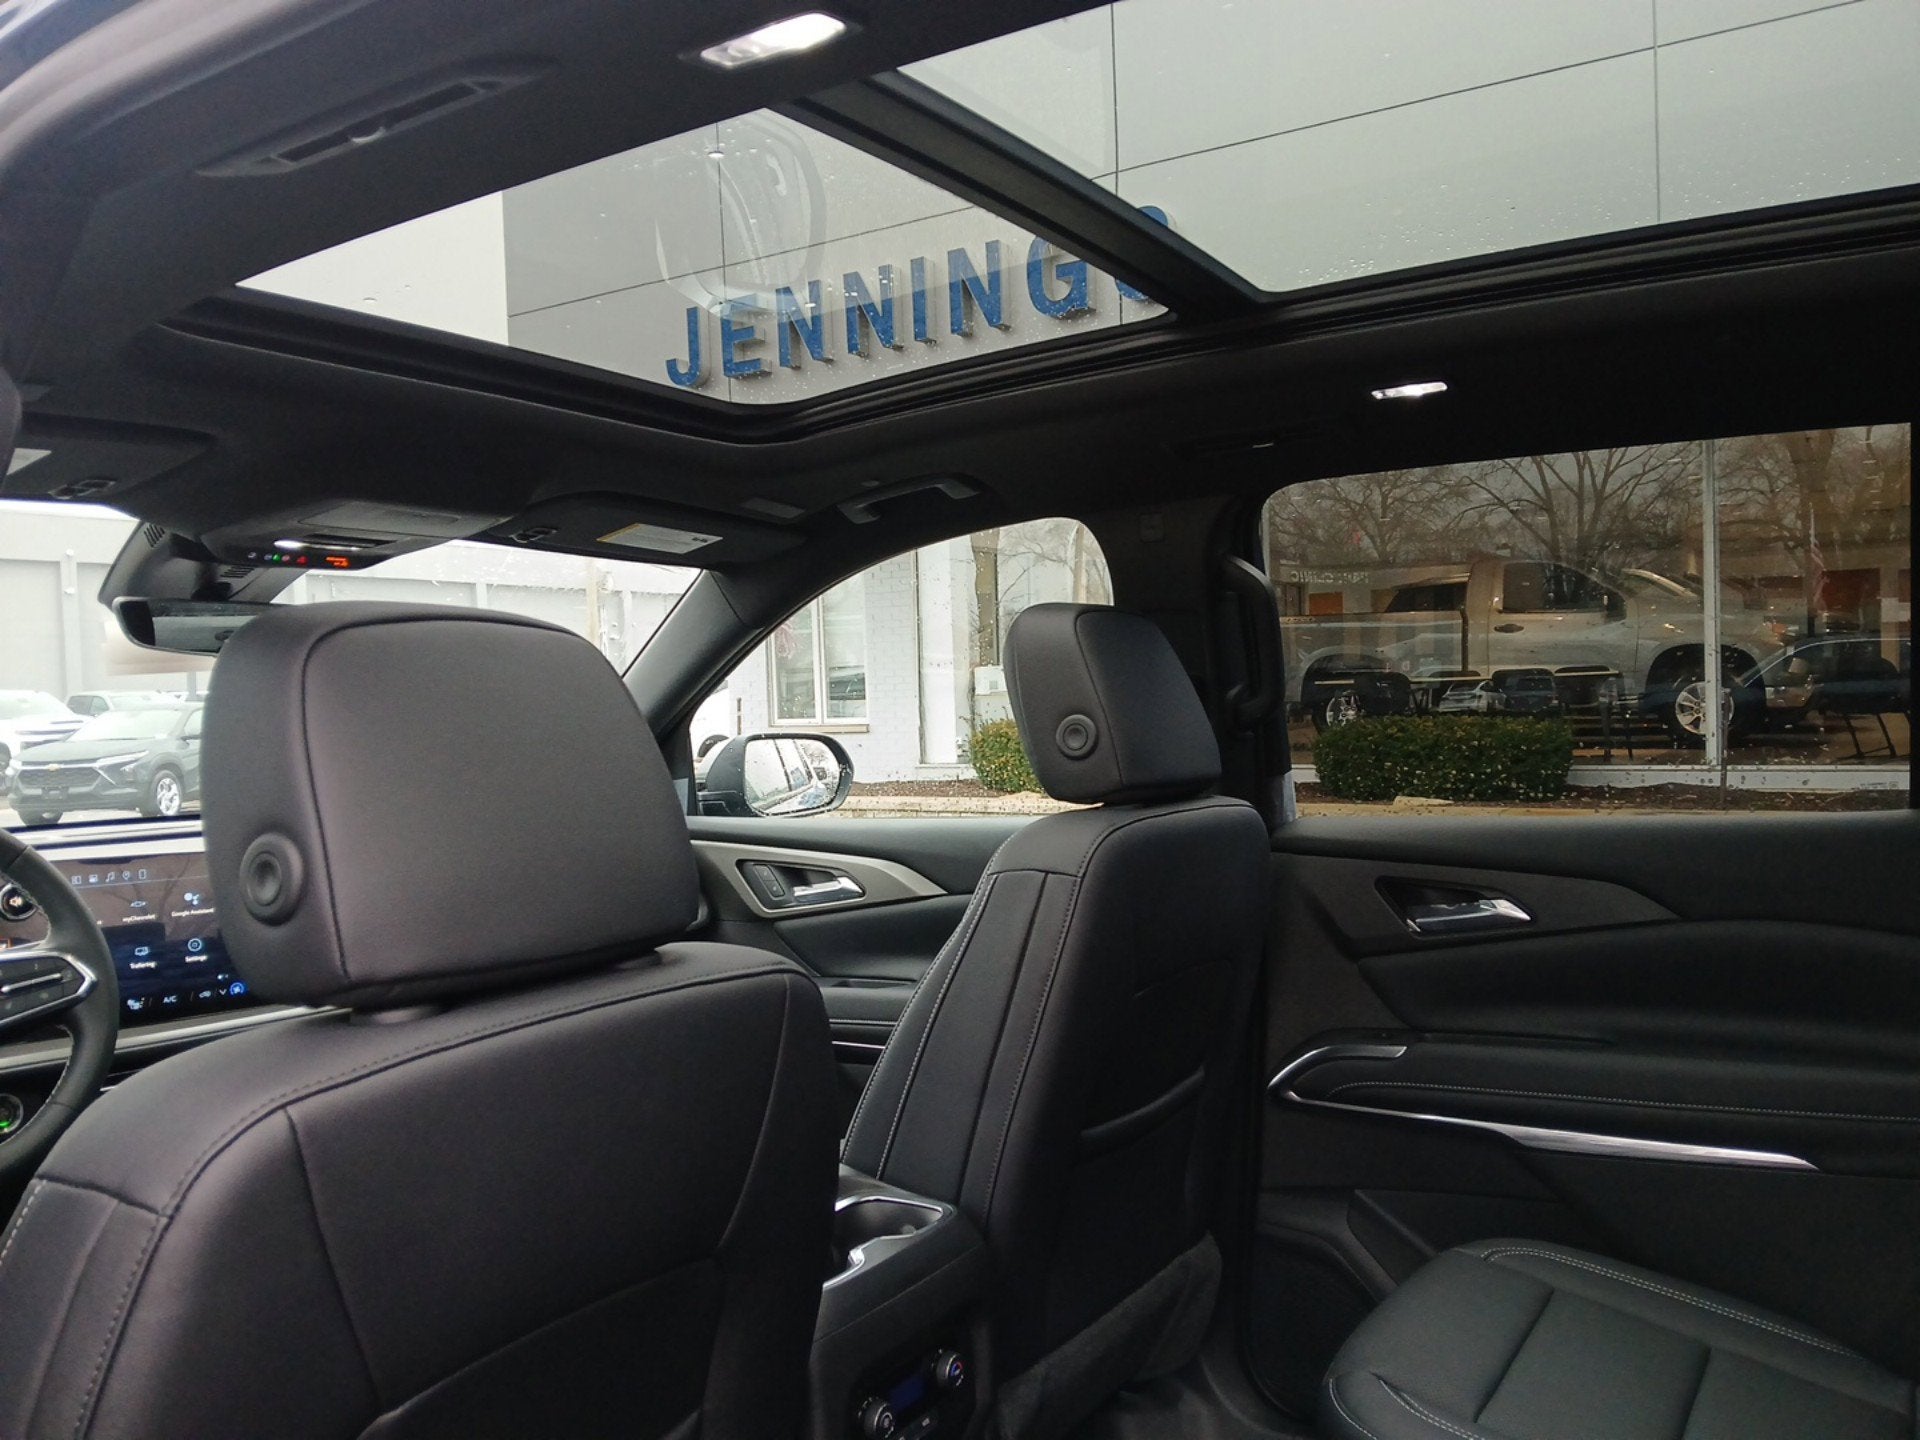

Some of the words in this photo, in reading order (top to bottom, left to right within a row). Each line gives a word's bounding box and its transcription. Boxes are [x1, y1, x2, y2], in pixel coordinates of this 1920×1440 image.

[171, 909, 190, 919] Google
[185, 954, 208, 963] Settings
[163, 995, 177, 1004] A/C
